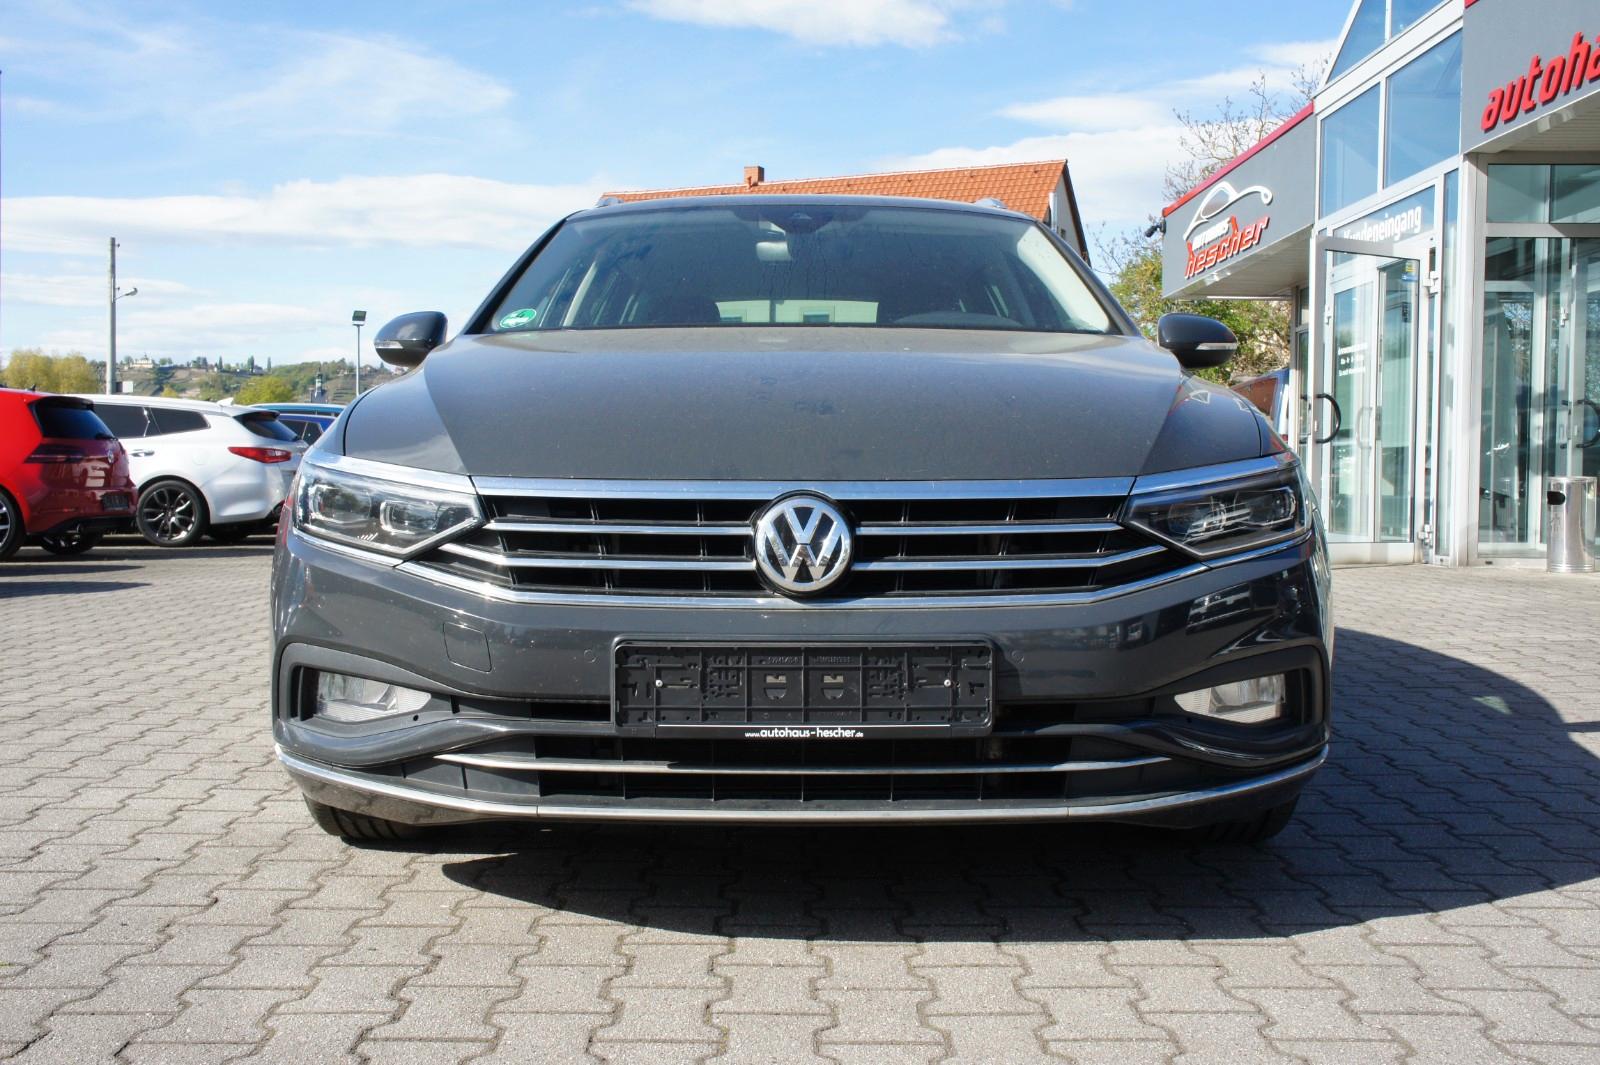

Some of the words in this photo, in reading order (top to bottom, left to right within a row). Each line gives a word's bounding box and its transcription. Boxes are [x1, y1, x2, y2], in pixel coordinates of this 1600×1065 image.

[1343, 206, 1422, 242] deneingang
[1184, 215, 1269, 279] hescher
[745, 727, 864, 738] www.autohaus-hescher.de
